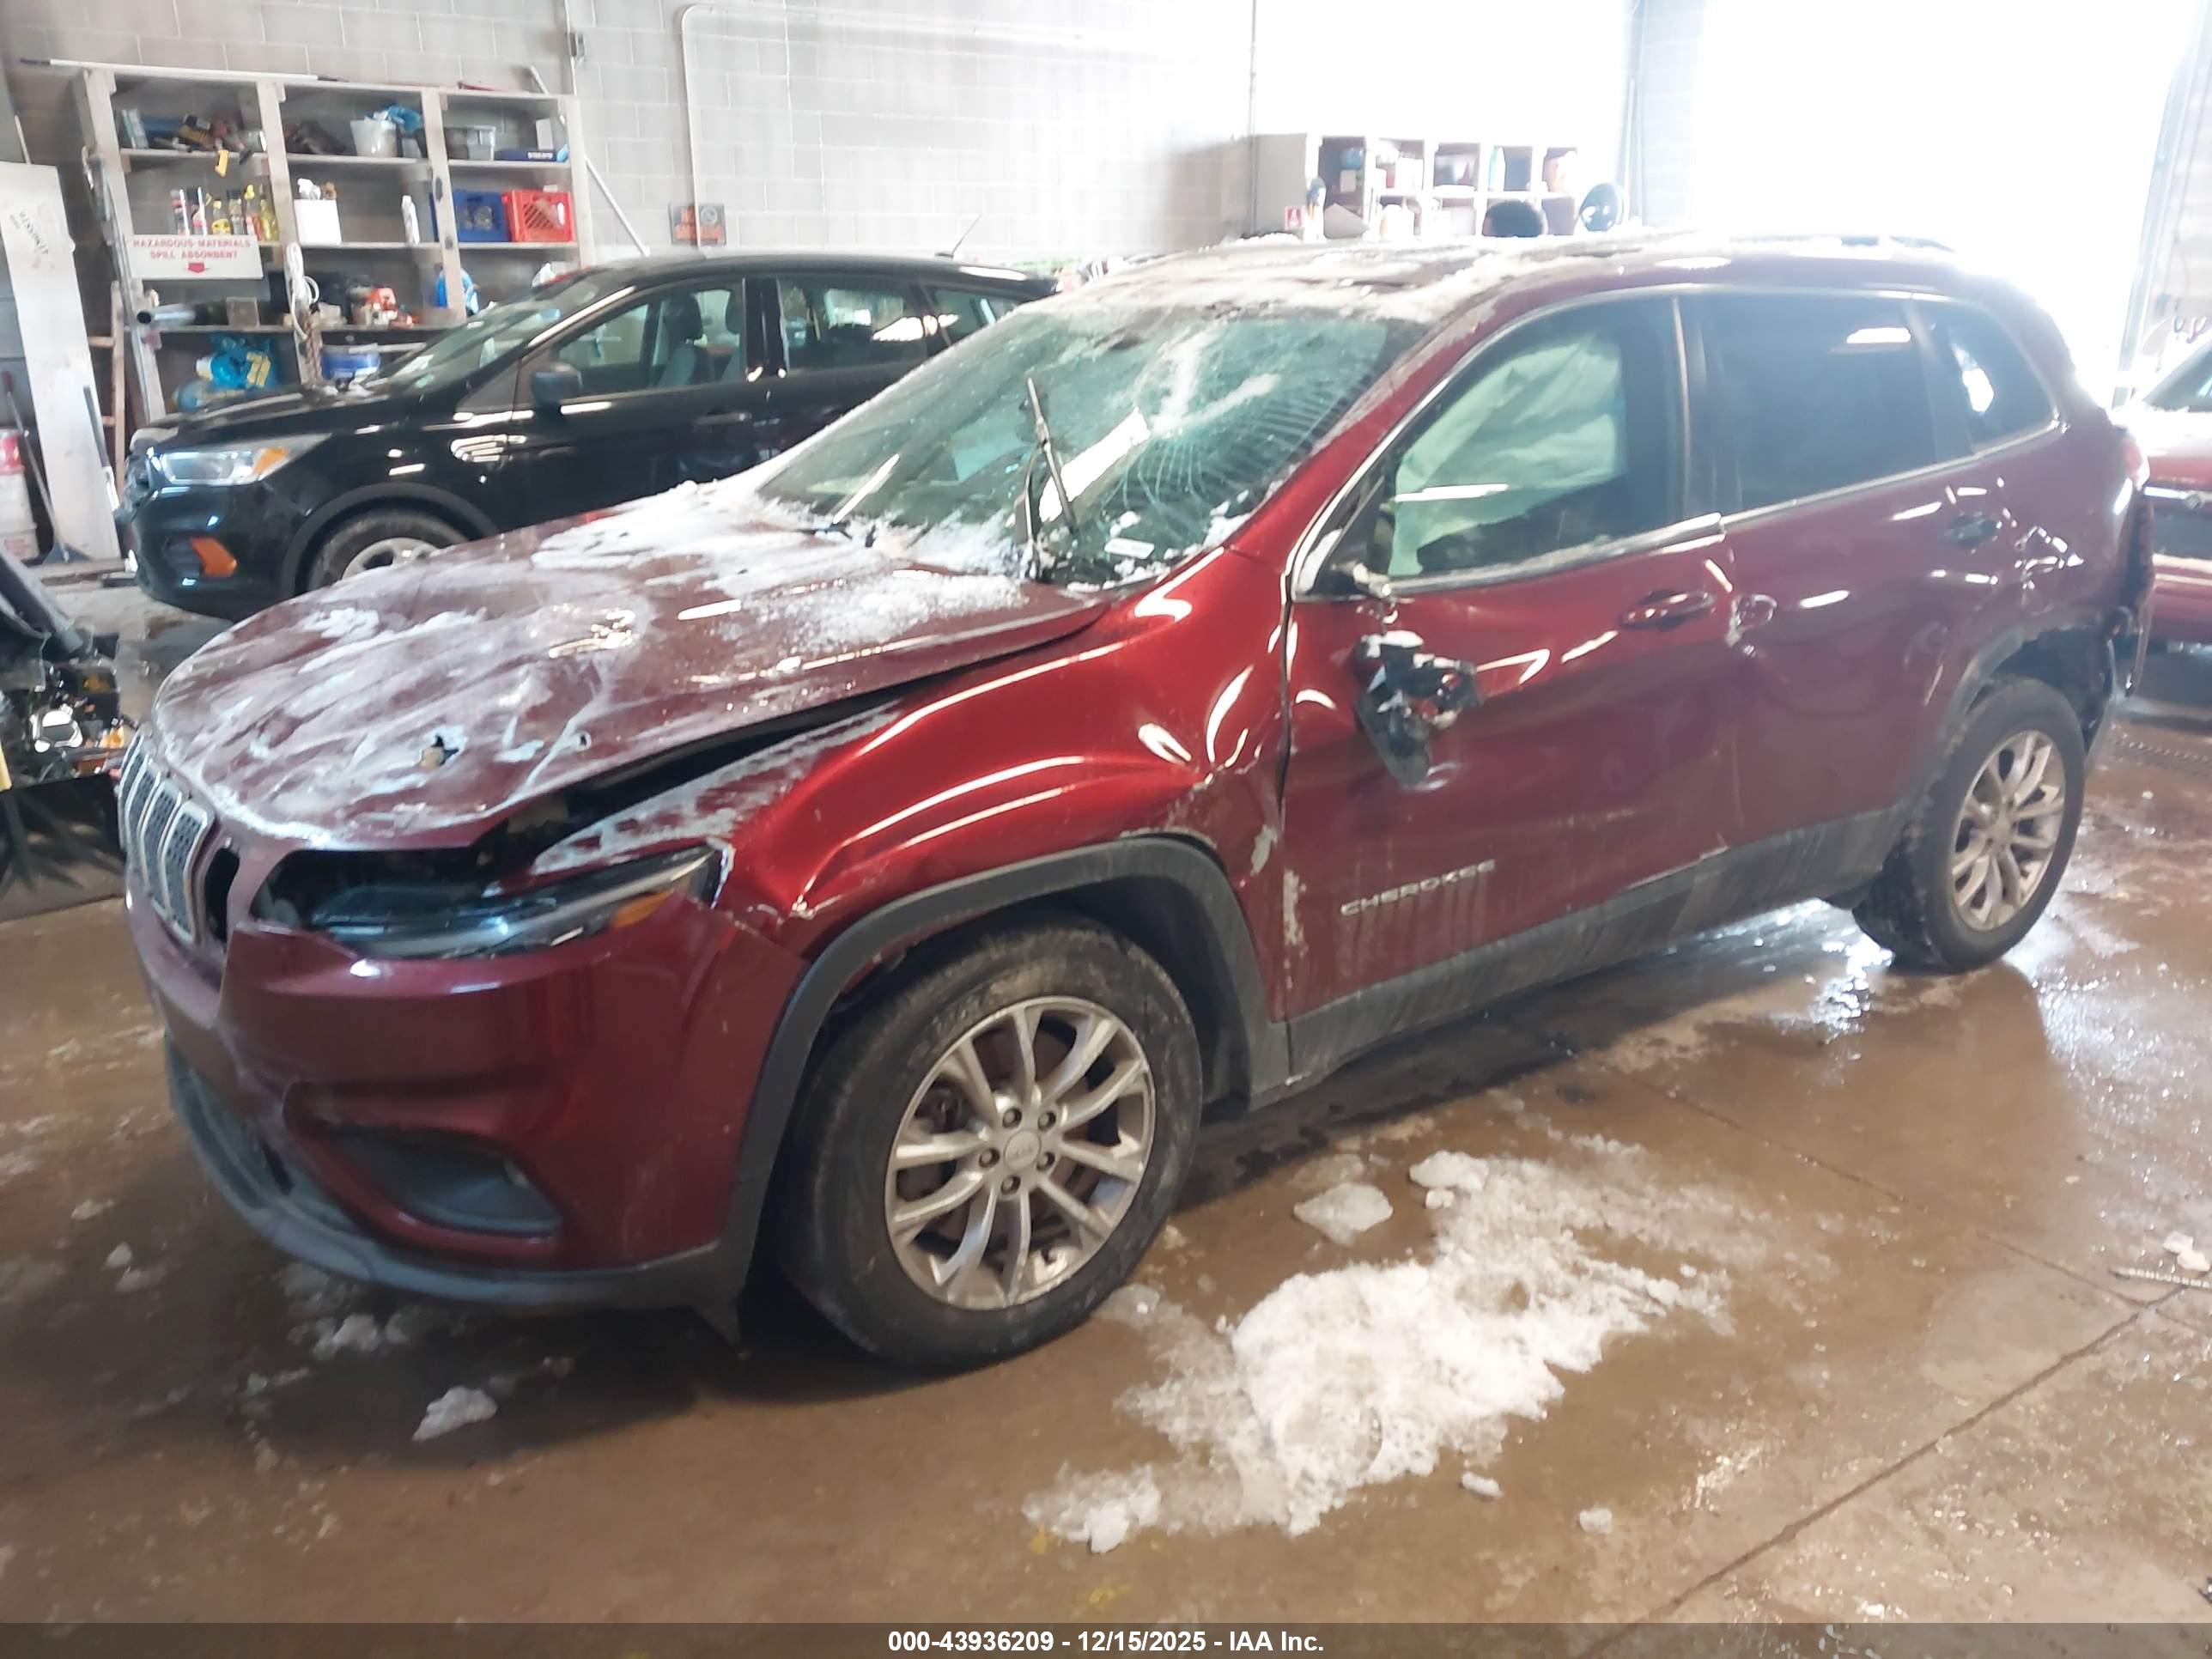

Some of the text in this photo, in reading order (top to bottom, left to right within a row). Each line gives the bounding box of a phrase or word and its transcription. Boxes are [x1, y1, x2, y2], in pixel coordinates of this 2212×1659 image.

[133, 238, 252, 248] HAZARDOUS MATERIALS
[149, 250, 238, 259] SPILL ABSORBENT
[1340, 858, 1496, 916] CHEROKEE
